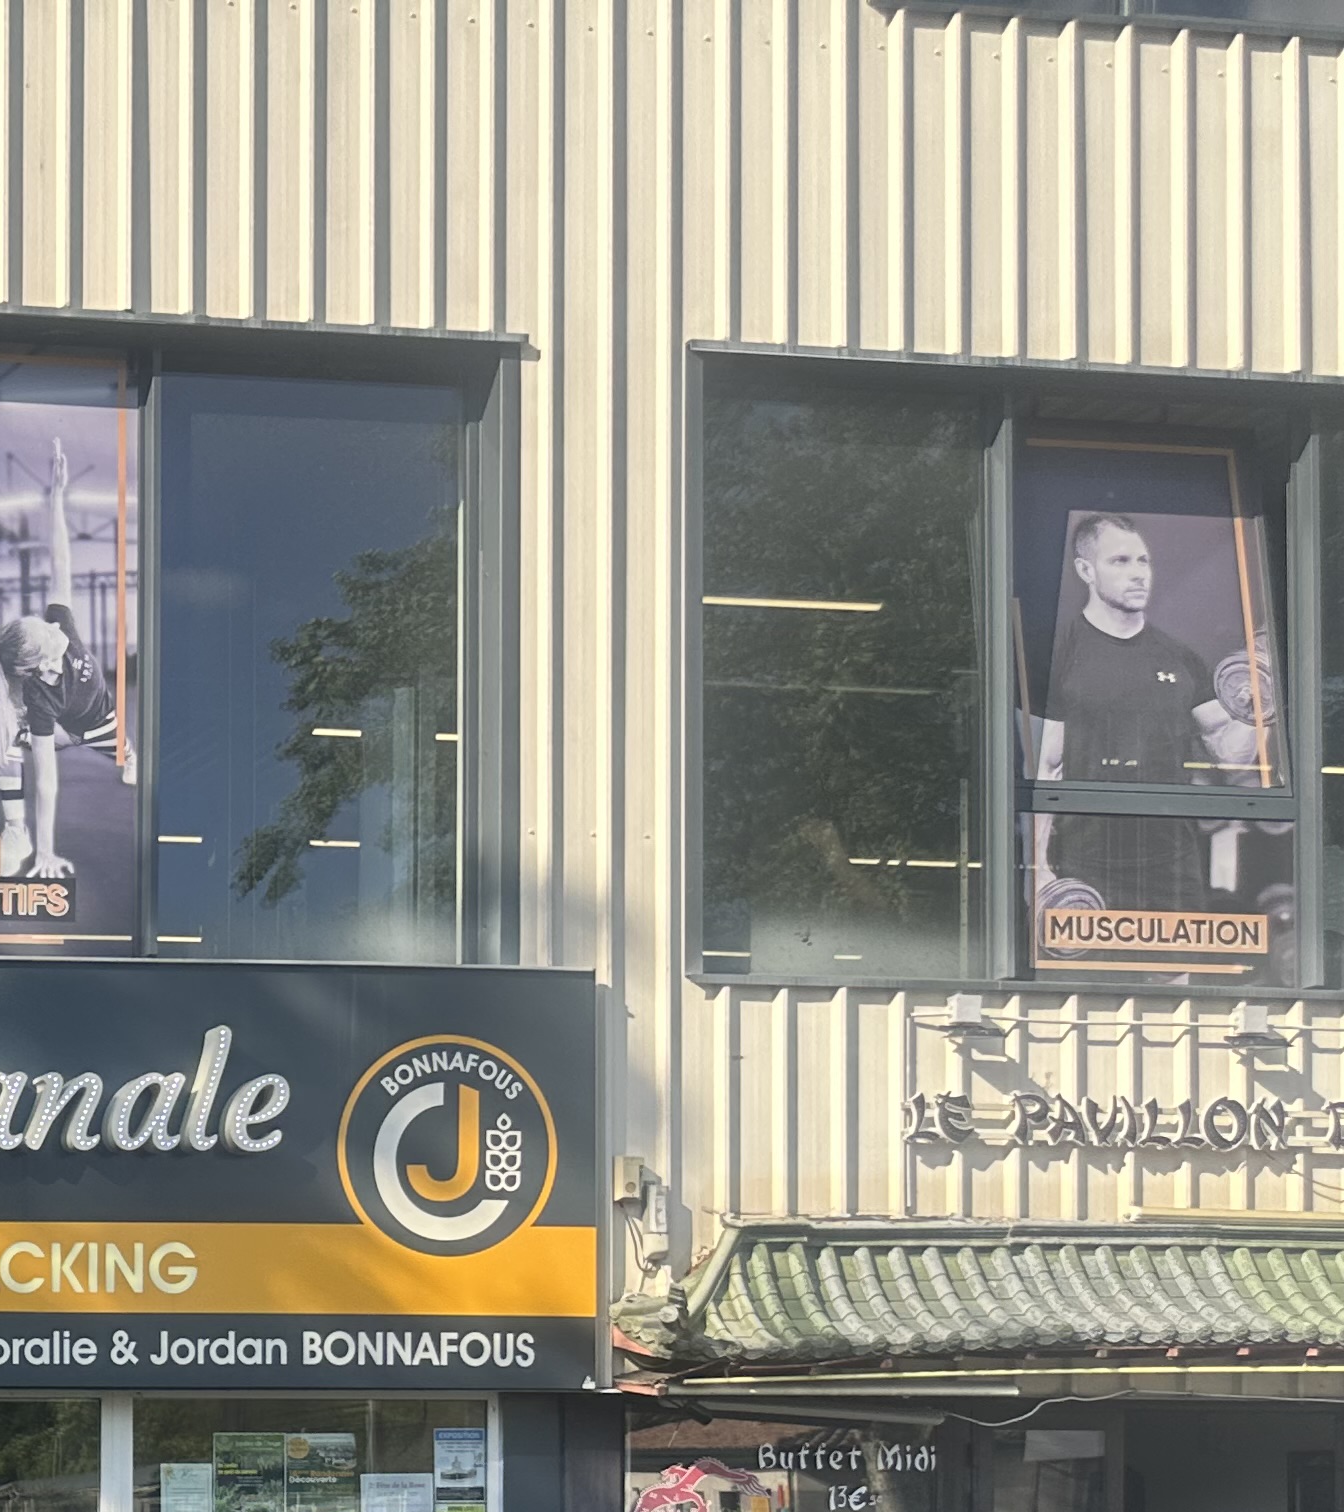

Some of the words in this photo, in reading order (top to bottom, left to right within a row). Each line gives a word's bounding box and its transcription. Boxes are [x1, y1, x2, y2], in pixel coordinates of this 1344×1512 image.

[1049, 915, 1260, 946] MUSCULATION
[380, 1051, 523, 1100] BONNAFOUS
[907, 1090, 975, 1144] LE
[1011, 1092, 1288, 1151] PAVILLON
[110, 1330, 139, 1366] &
[150, 1331, 287, 1366] Jordan
[302, 1331, 536, 1368] BONNAFOUS
[758, 1443, 861, 1470] Buffet
[877, 1441, 937, 1472] Midi
